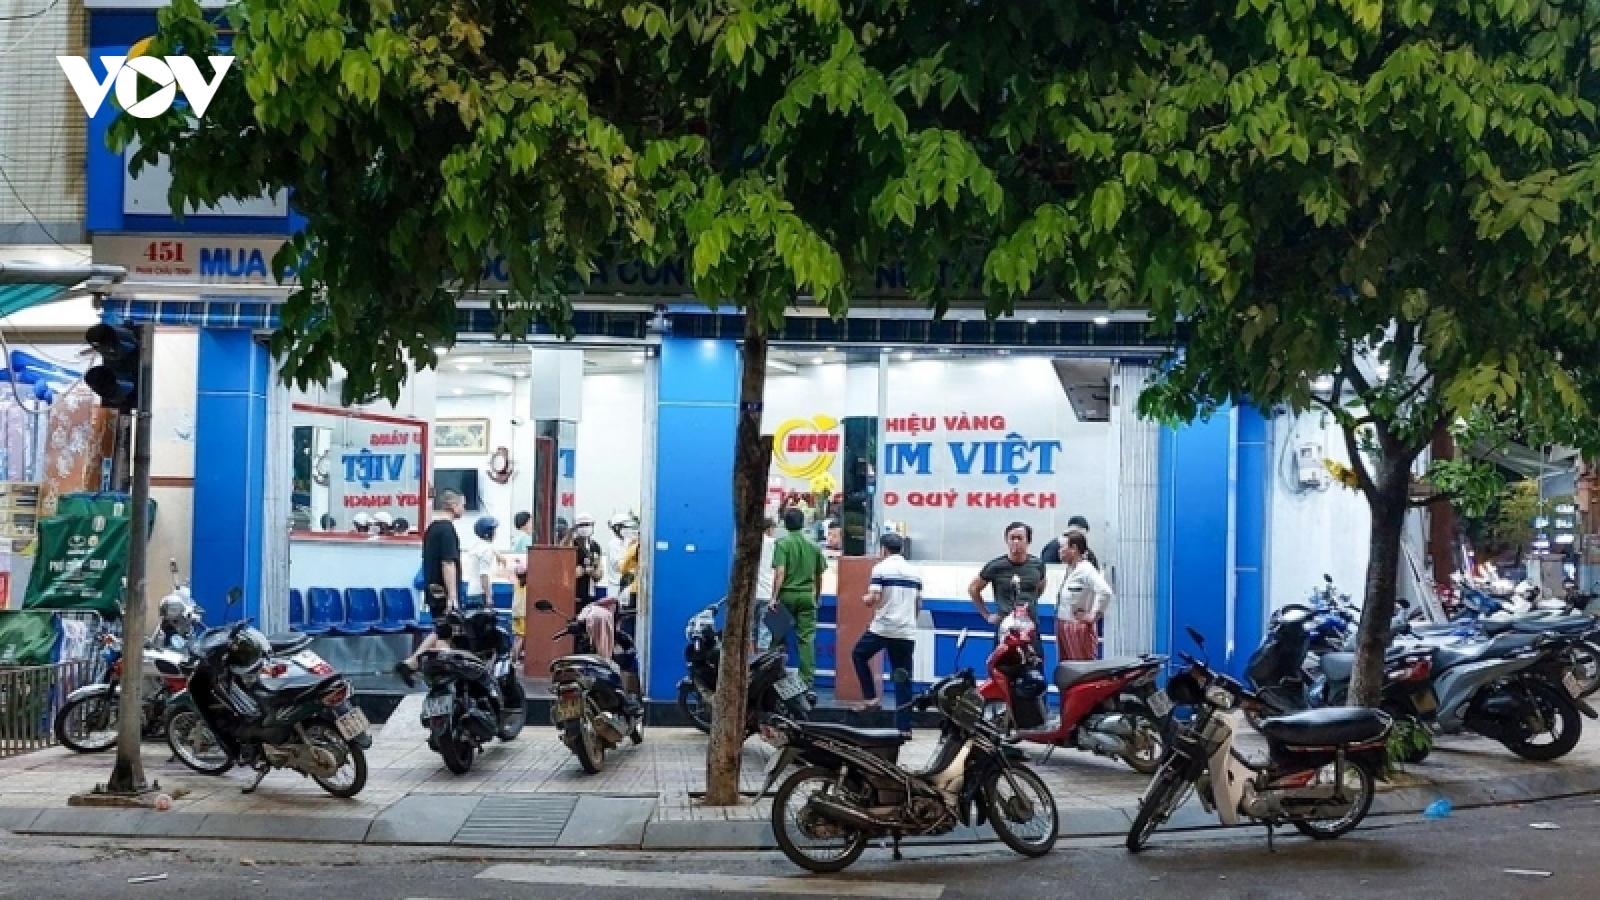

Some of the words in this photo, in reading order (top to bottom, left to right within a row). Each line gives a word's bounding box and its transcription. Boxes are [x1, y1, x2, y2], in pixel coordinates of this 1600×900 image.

[142, 241, 185, 263] 451
[199, 247, 268, 278] MUA
[885, 412, 936, 436] HIỆU
[943, 411, 1006, 431] VÀNG
[884, 441, 933, 475] IM
[947, 431, 1062, 485] VIỆT
[906, 487, 959, 509] QUÝ
[966, 487, 1057, 509] KHÁCH
